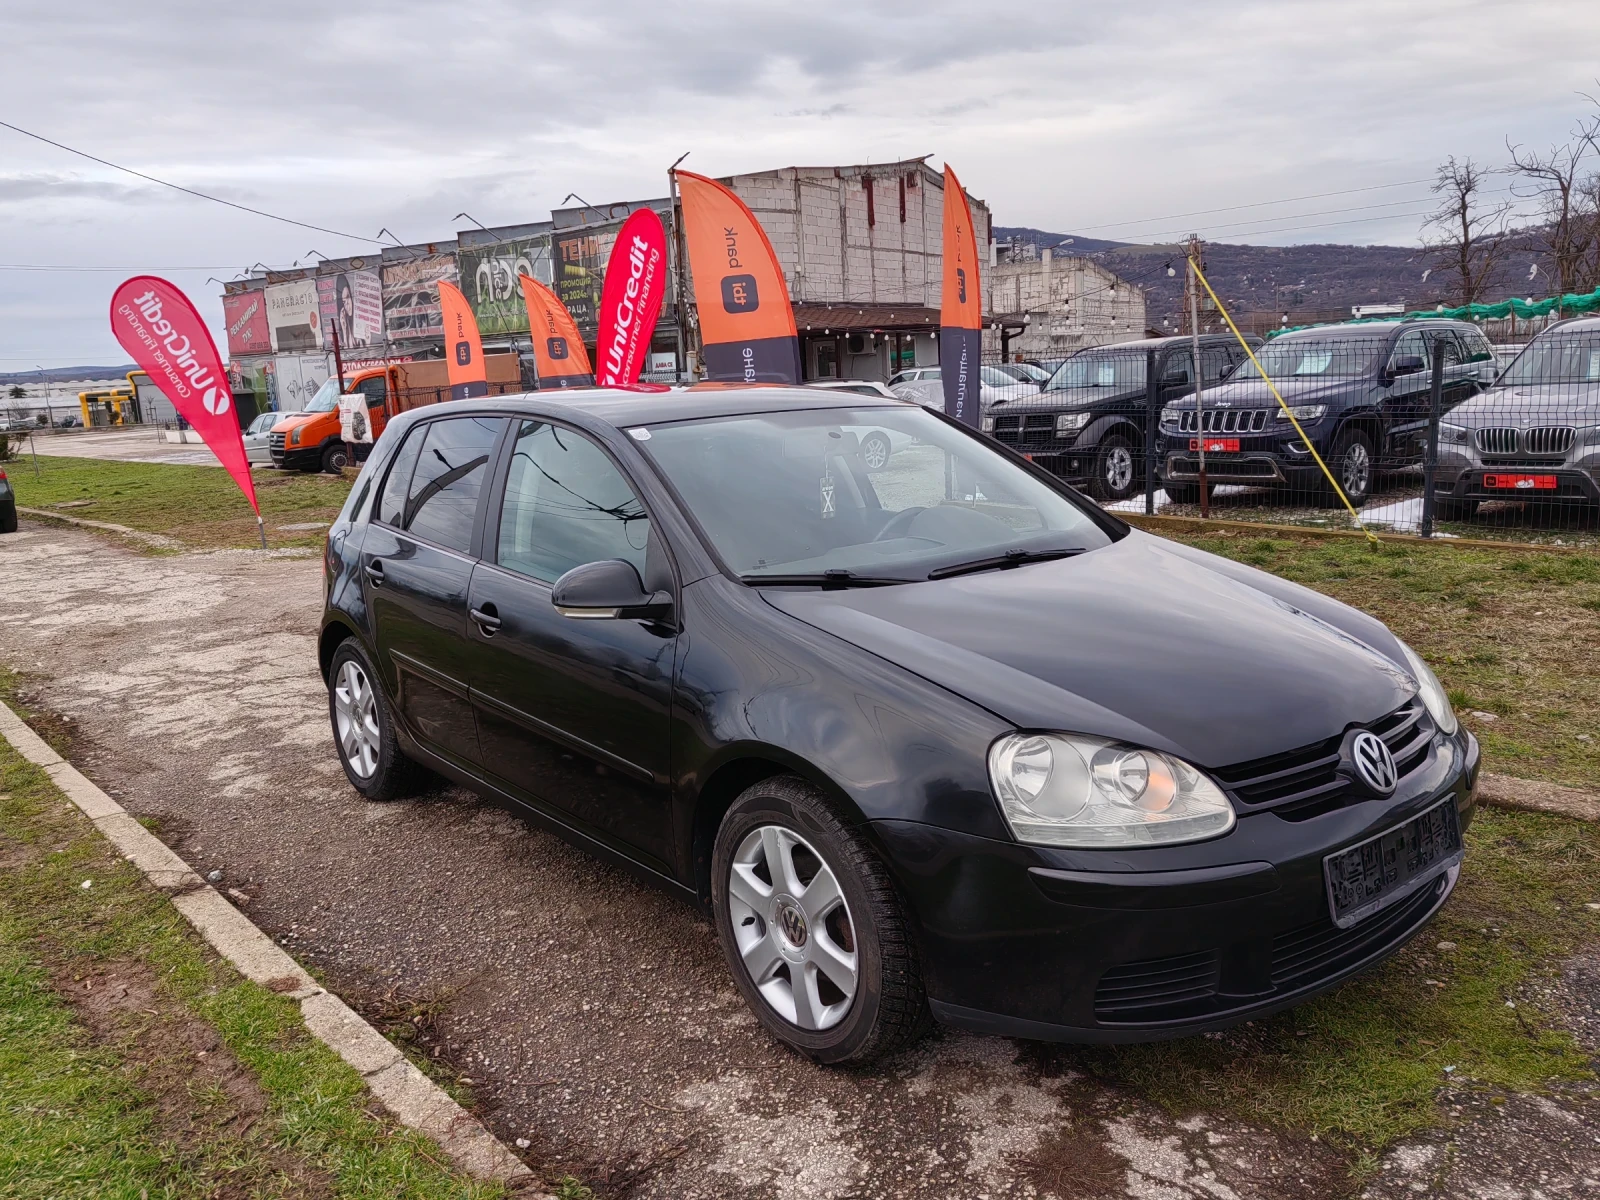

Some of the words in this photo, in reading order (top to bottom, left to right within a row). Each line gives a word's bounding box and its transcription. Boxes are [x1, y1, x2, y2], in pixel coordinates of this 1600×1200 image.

[560, 277, 592, 289] ПРОМОЦИЯ
[567, 304, 590, 314] РАЦА,
[607, 235, 649, 379] UniCredit
[622, 316, 643, 385] Consumer
[637, 247, 660, 316] Financing
